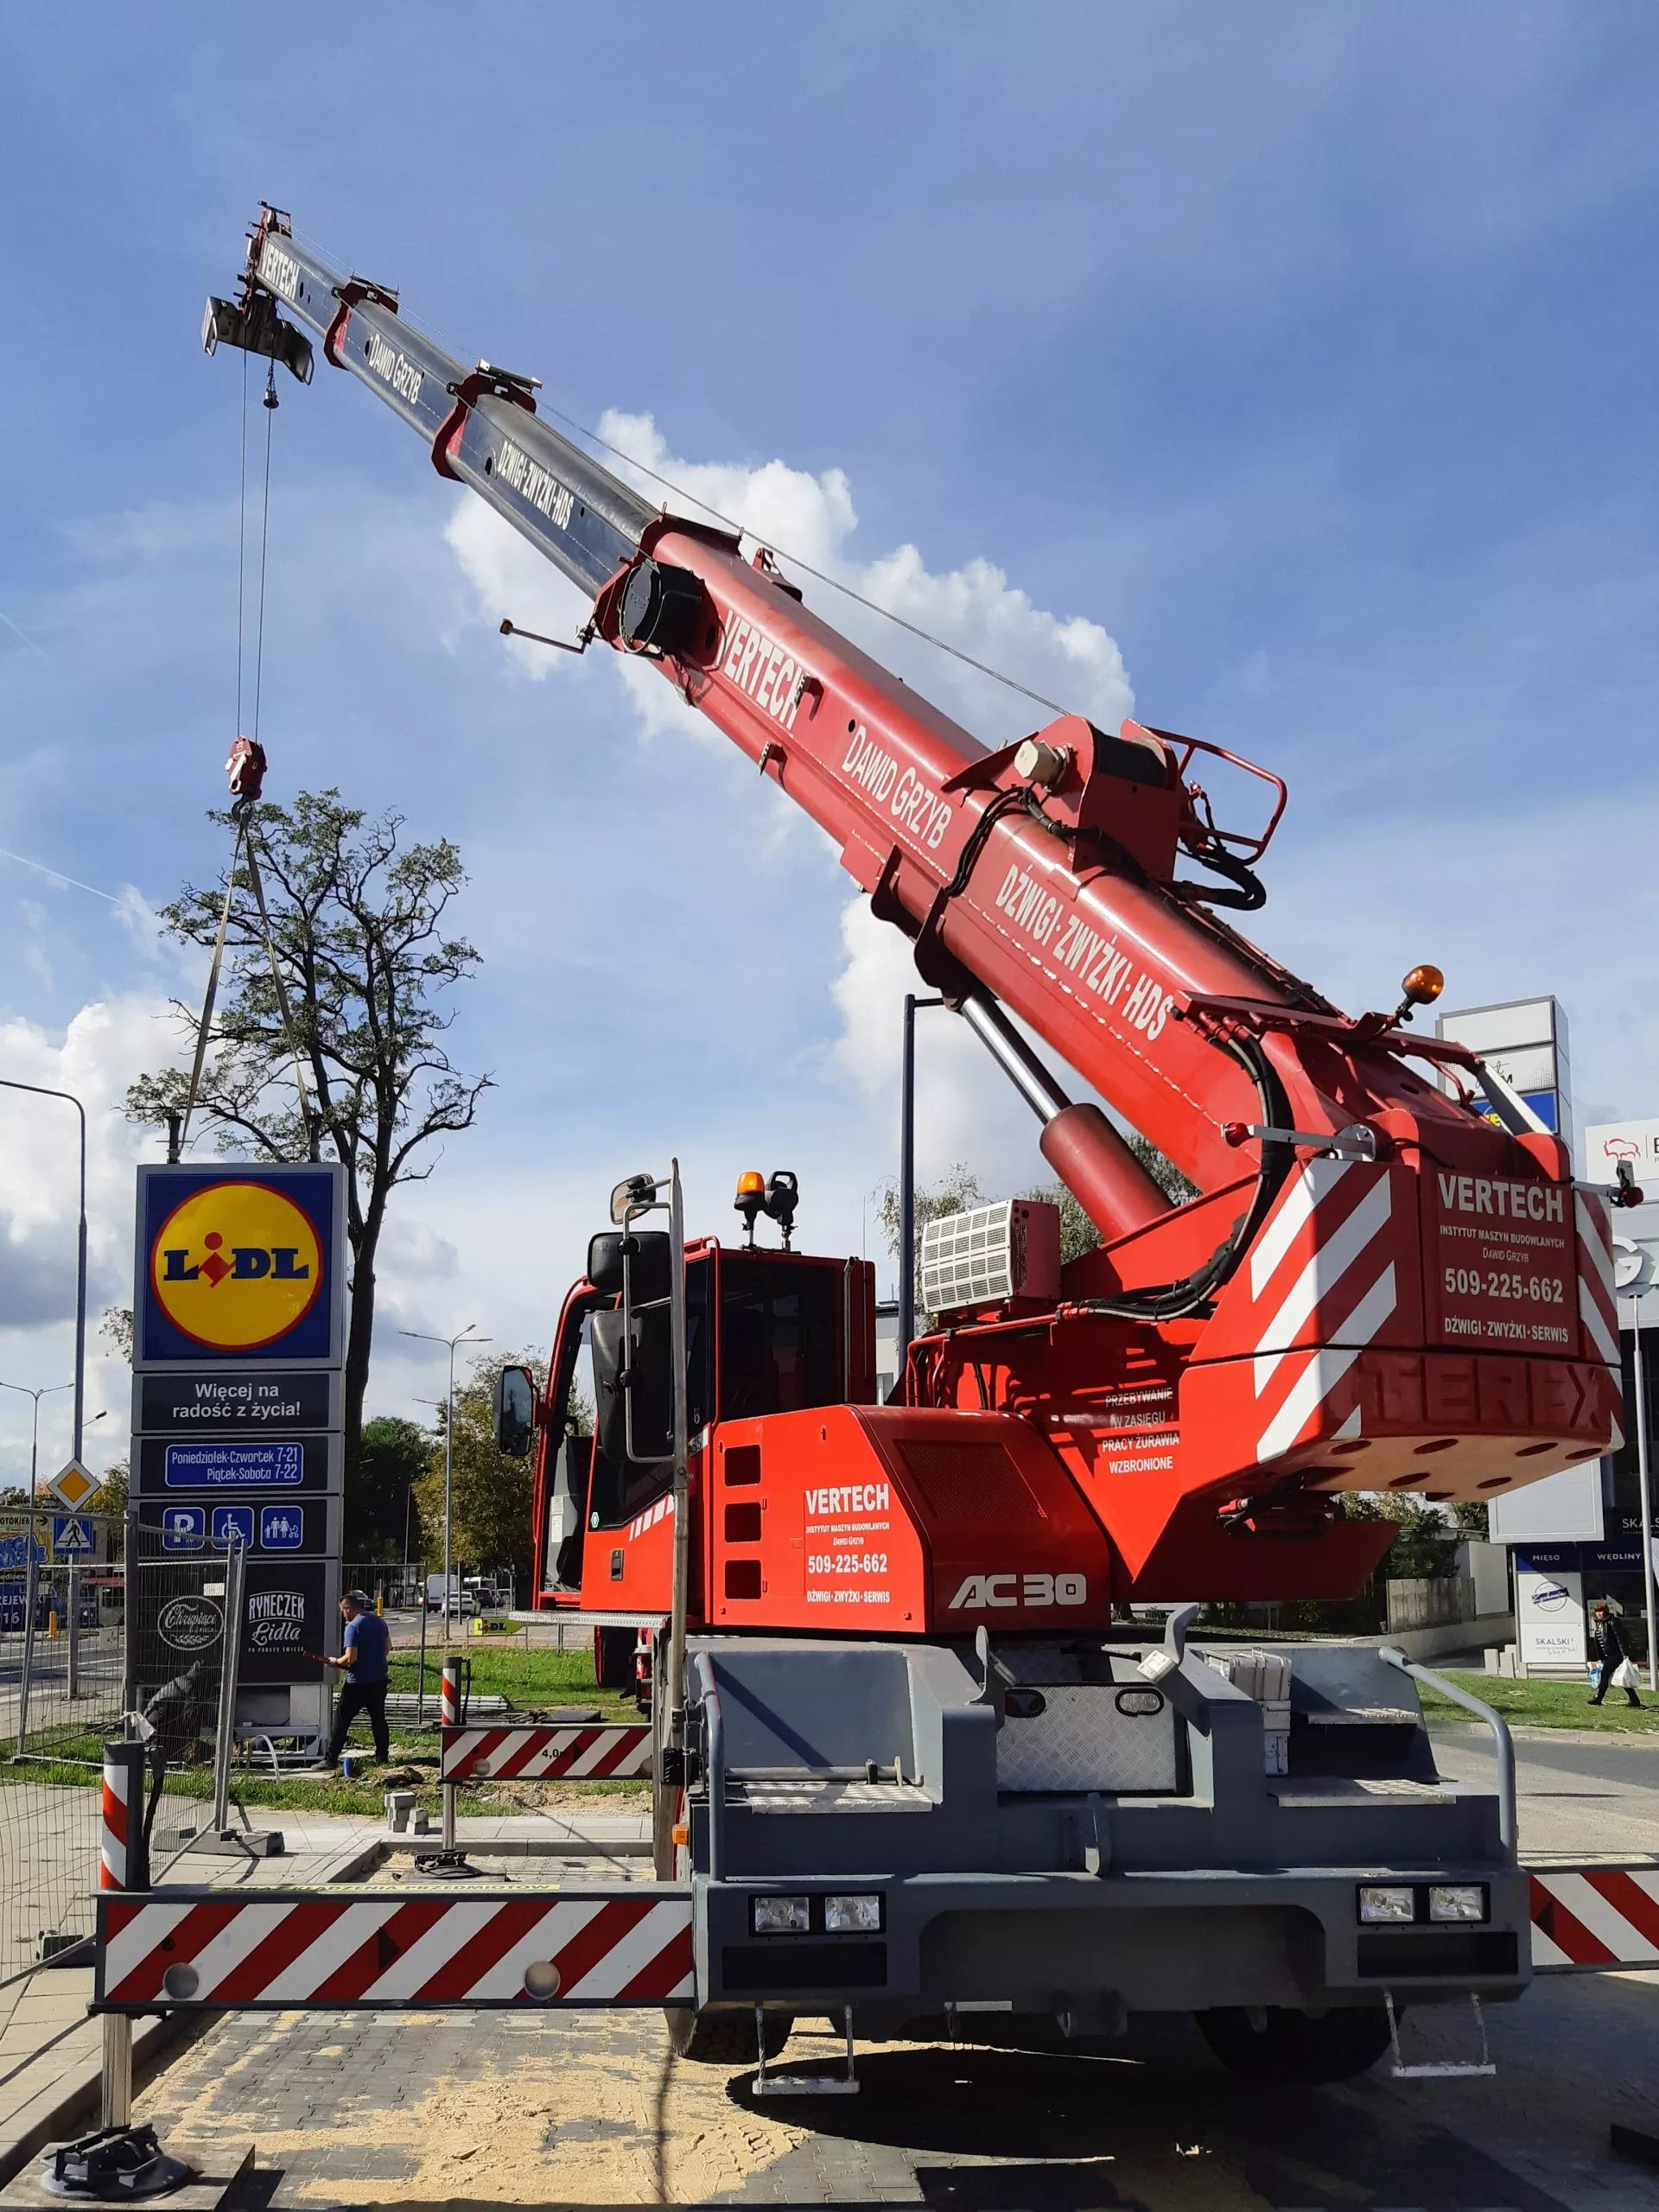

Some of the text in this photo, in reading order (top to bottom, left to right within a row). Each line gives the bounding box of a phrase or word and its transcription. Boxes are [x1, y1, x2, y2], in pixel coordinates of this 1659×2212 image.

[262, 239, 300, 302] VERTECH
[369, 333, 422, 404] DAWID GRZYB
[716, 609, 806, 730] VERTECH
[842, 725, 952, 849] DAWID GRZYB
[1438, 1173, 1563, 1224] VERTECH
[1440, 1225, 1565, 1249] INSTYTUT MASZYN BUDOWLANYCH
[163, 1232, 308, 1287] LIDL
[1483, 1247, 1529, 1263] DAWID GRZYB
[1445, 1268, 1563, 1304] 509-225-662
[195, 1382, 279, 1401] Więcej na
[1106, 1387, 1173, 1407] PRZEBYWANIE
[1357, 1355, 1603, 1430] TEREX
[173, 1402, 301, 1420] radość z życia!
[1113, 1411, 1166, 1429] W ZASIĘGU
[1103, 1433, 1179, 1452] PRACY ŻURAWIA
[172, 1446, 298, 1465] Poniedziałek-Czwartek 7-21
[1109, 1456, 1173, 1474] WZBRONIONE
[207, 1464, 297, 1482] Piątek-Sobota 7-22
[805, 1483, 889, 1515] VERTECH
[806, 1525, 830, 1534] INSTYTUT
[852, 1522, 890, 1532] BUDOWLANYCH
[833, 1537, 848, 1546] DAWID
[808, 1553, 887, 1573] 509-225-662
[1597, 1553, 1642, 1561] WĘDLINY
[248, 1594, 305, 1621] RYNECZEK
[251, 1622, 302, 1646] Lidla
